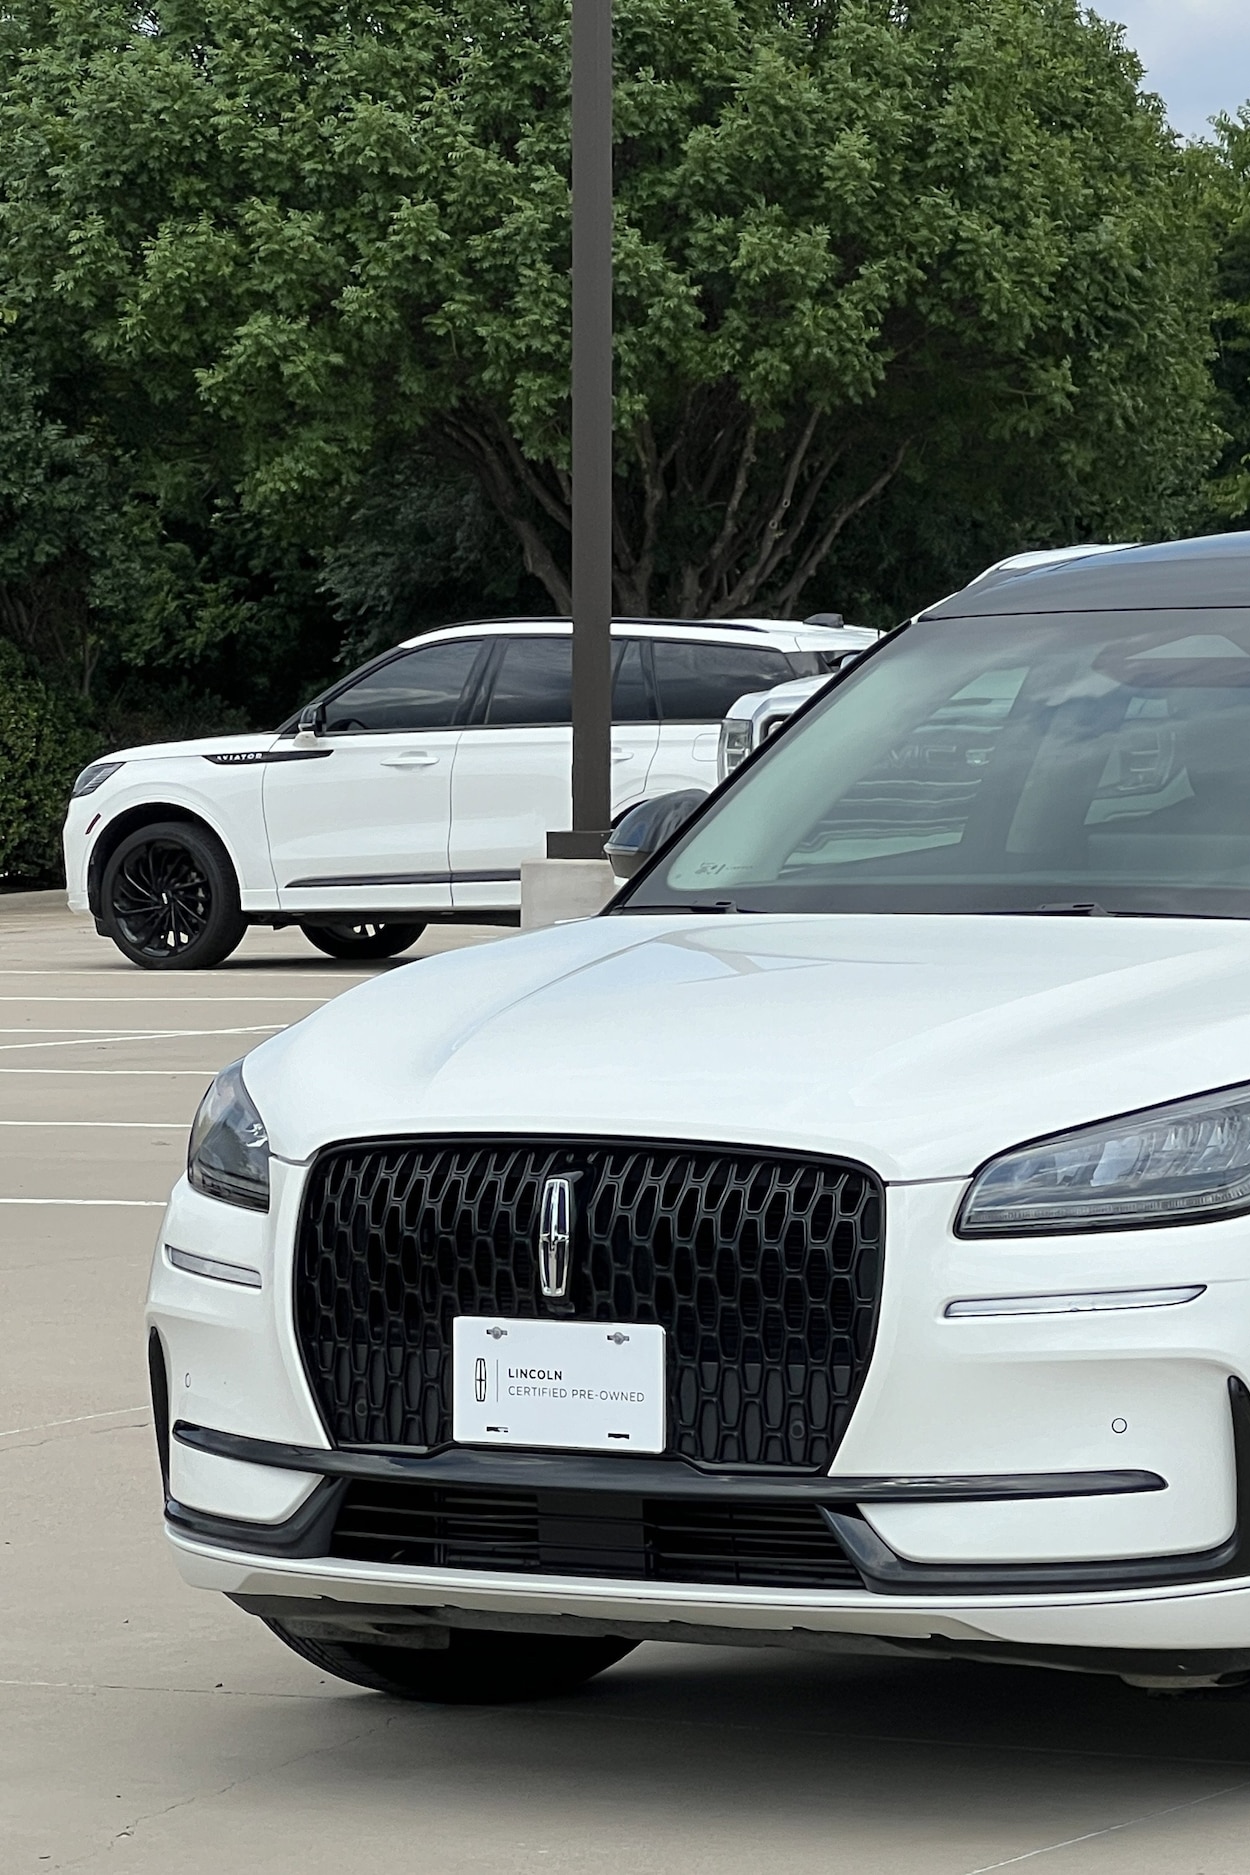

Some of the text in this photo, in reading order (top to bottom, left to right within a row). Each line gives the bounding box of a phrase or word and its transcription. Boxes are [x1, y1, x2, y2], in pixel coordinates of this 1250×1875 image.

[216, 752, 263, 761] AVIATOR
[507, 1367, 563, 1381] LINCOLN
[507, 1385, 645, 1403] CERTIFIED PRE-OWNED
